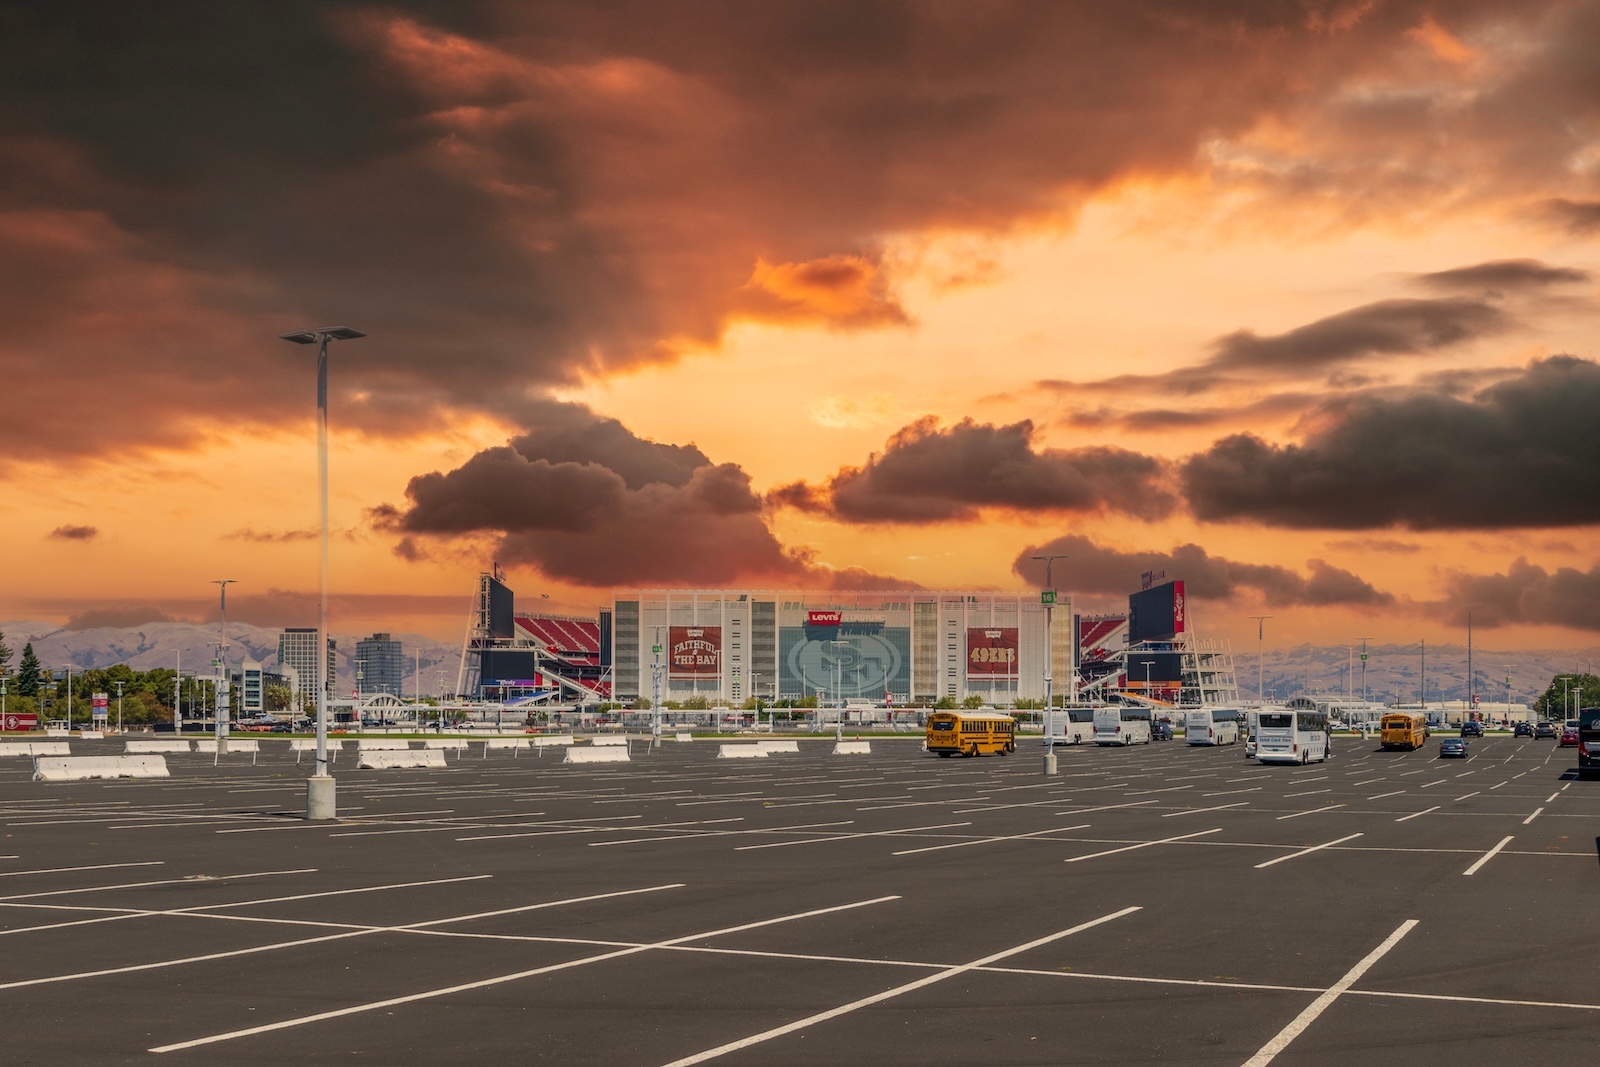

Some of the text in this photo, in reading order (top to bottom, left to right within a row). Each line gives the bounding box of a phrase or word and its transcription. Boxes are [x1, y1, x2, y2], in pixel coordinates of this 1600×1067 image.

[1043, 594, 1052, 602] 16
[674, 640, 717, 655] FAITHFUL
[674, 655, 716, 665] THE BAY
[971, 647, 1016, 663] 49ERS
